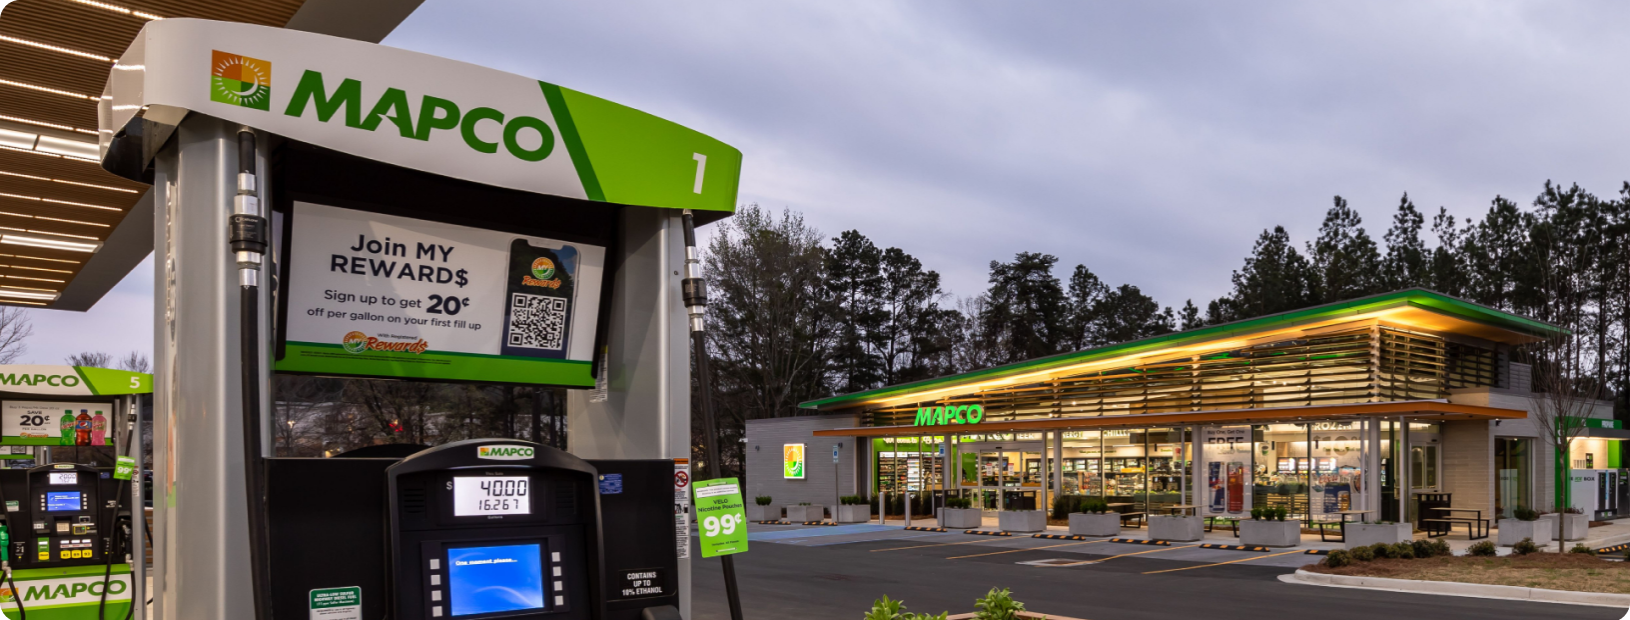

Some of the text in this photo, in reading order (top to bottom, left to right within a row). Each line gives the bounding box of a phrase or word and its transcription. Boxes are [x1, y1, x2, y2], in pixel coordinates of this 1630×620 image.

[284, 69, 555, 162] MAPCO
[692, 152, 707, 194] 1
[350, 234, 455, 263] Join MY
[331, 254, 469, 288] REWARD$
[324, 289, 470, 316] Sign up to get 20¢
[307, 308, 482, 331] off per gallon on your first fill up
[0, 373, 80, 387] MAPCO
[129, 376, 141, 389] 5
[19, 415, 50, 427] 20¢
[914, 404, 983, 427] MAPCO
[1312, 422, 1352, 430] ROZEN
[490, 447, 534, 457] MAPCO
[446, 481, 453, 490] $
[480, 480, 527, 497] 40.00
[479, 499, 519, 511] 16.267
[698, 505, 721, 513] Nicotine
[703, 512, 742, 537] 99¢
[627, 571, 657, 580] CONTAINS
[633, 579, 651, 588] UP TO
[23, 580, 127, 602] MAPCO
[622, 586, 663, 596] 10% ETHANOL
